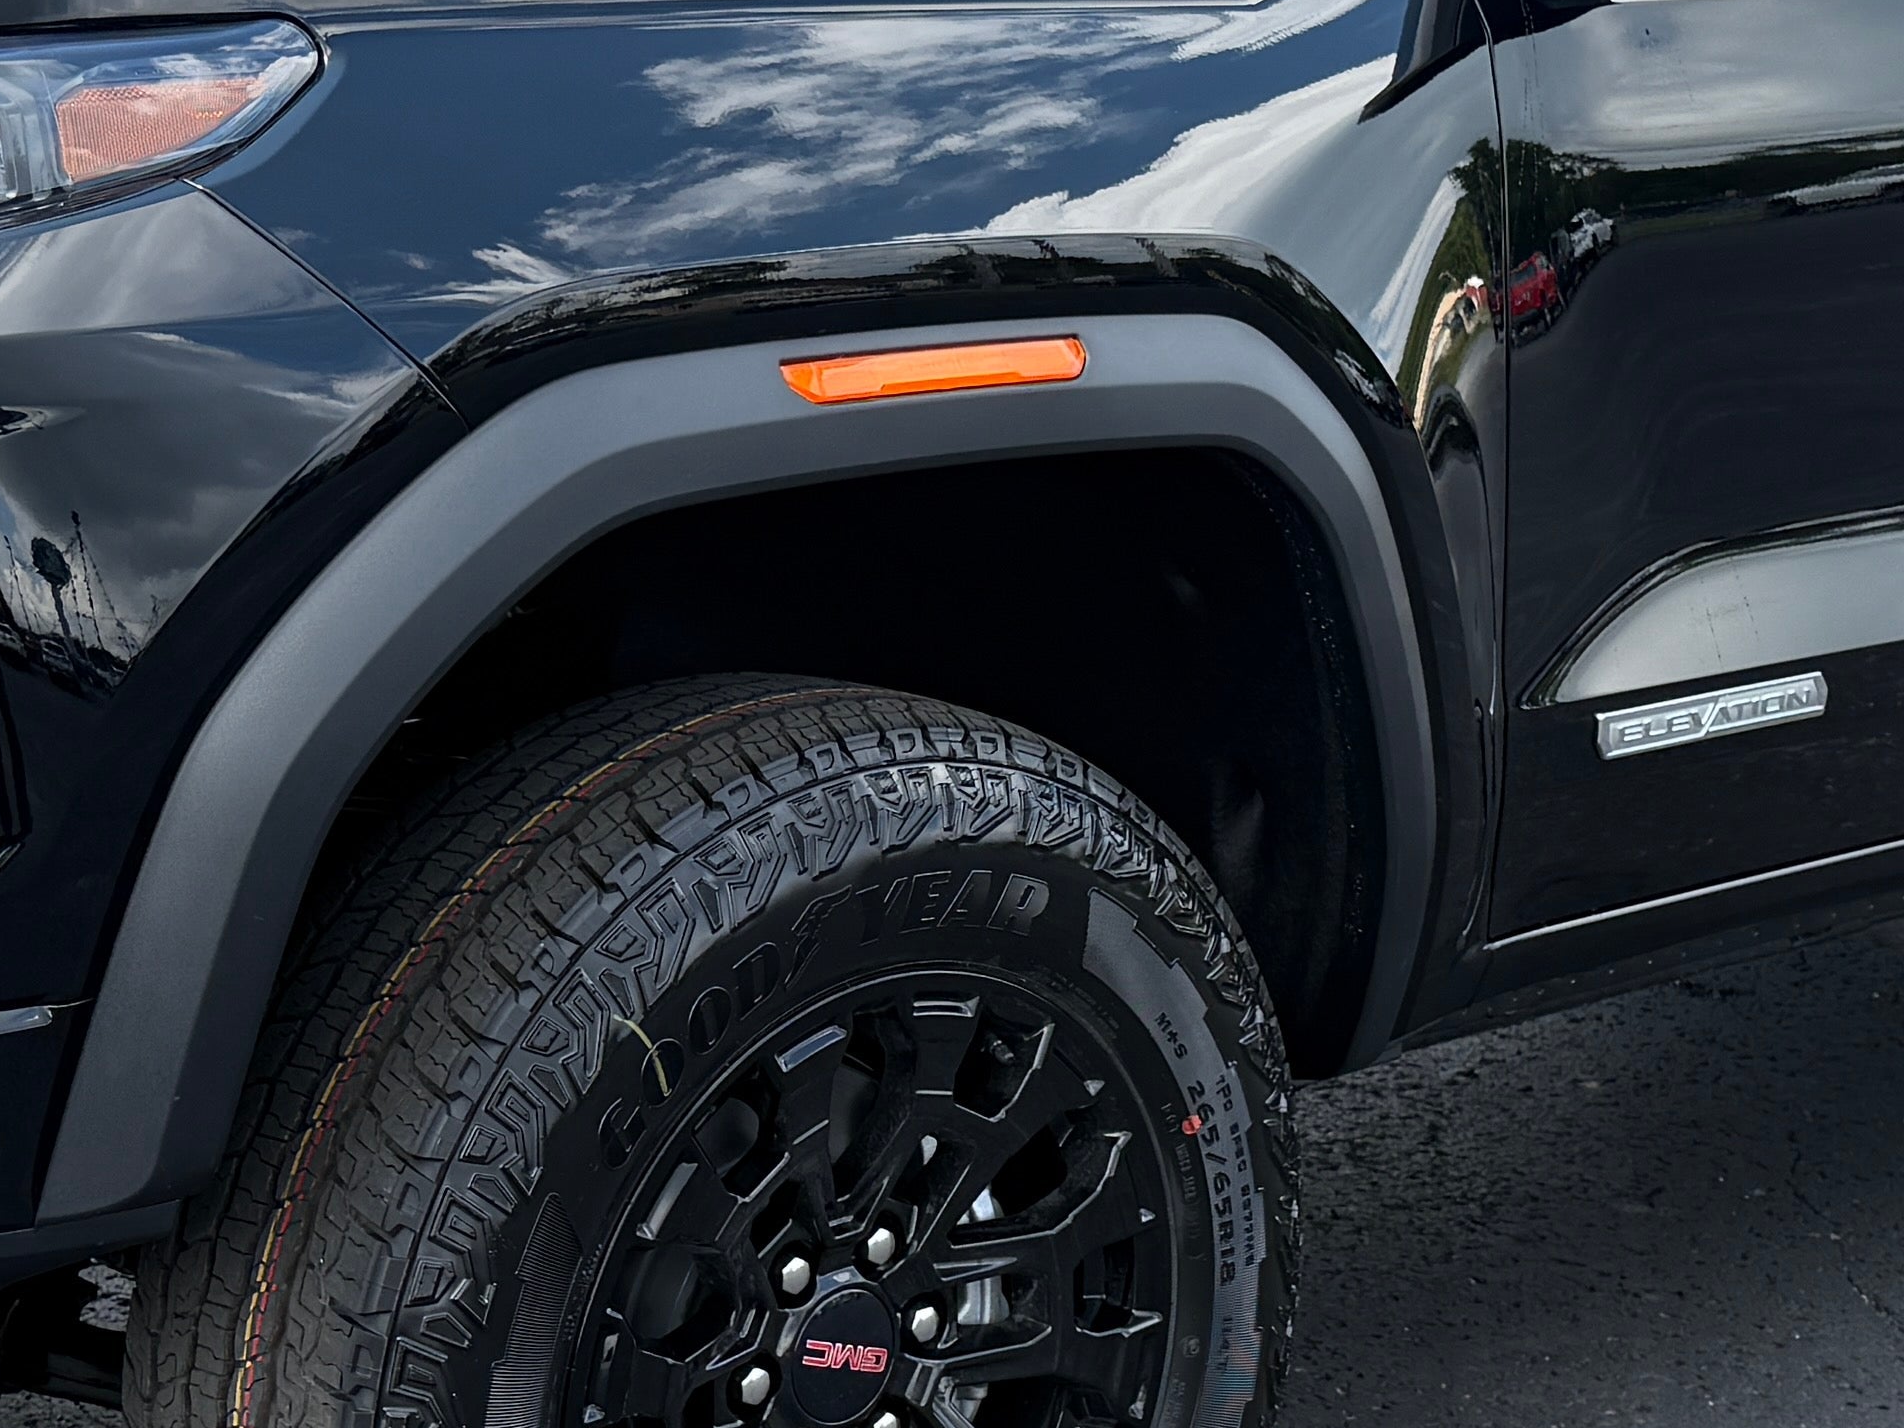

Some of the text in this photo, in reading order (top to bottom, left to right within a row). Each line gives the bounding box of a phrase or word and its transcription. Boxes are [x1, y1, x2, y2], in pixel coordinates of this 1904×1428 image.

[1616, 688, 1811, 742] ELEVATION
[1186, 1077, 1237, 1287] 265/65R18
[801, 1338, 888, 1373] GMC
